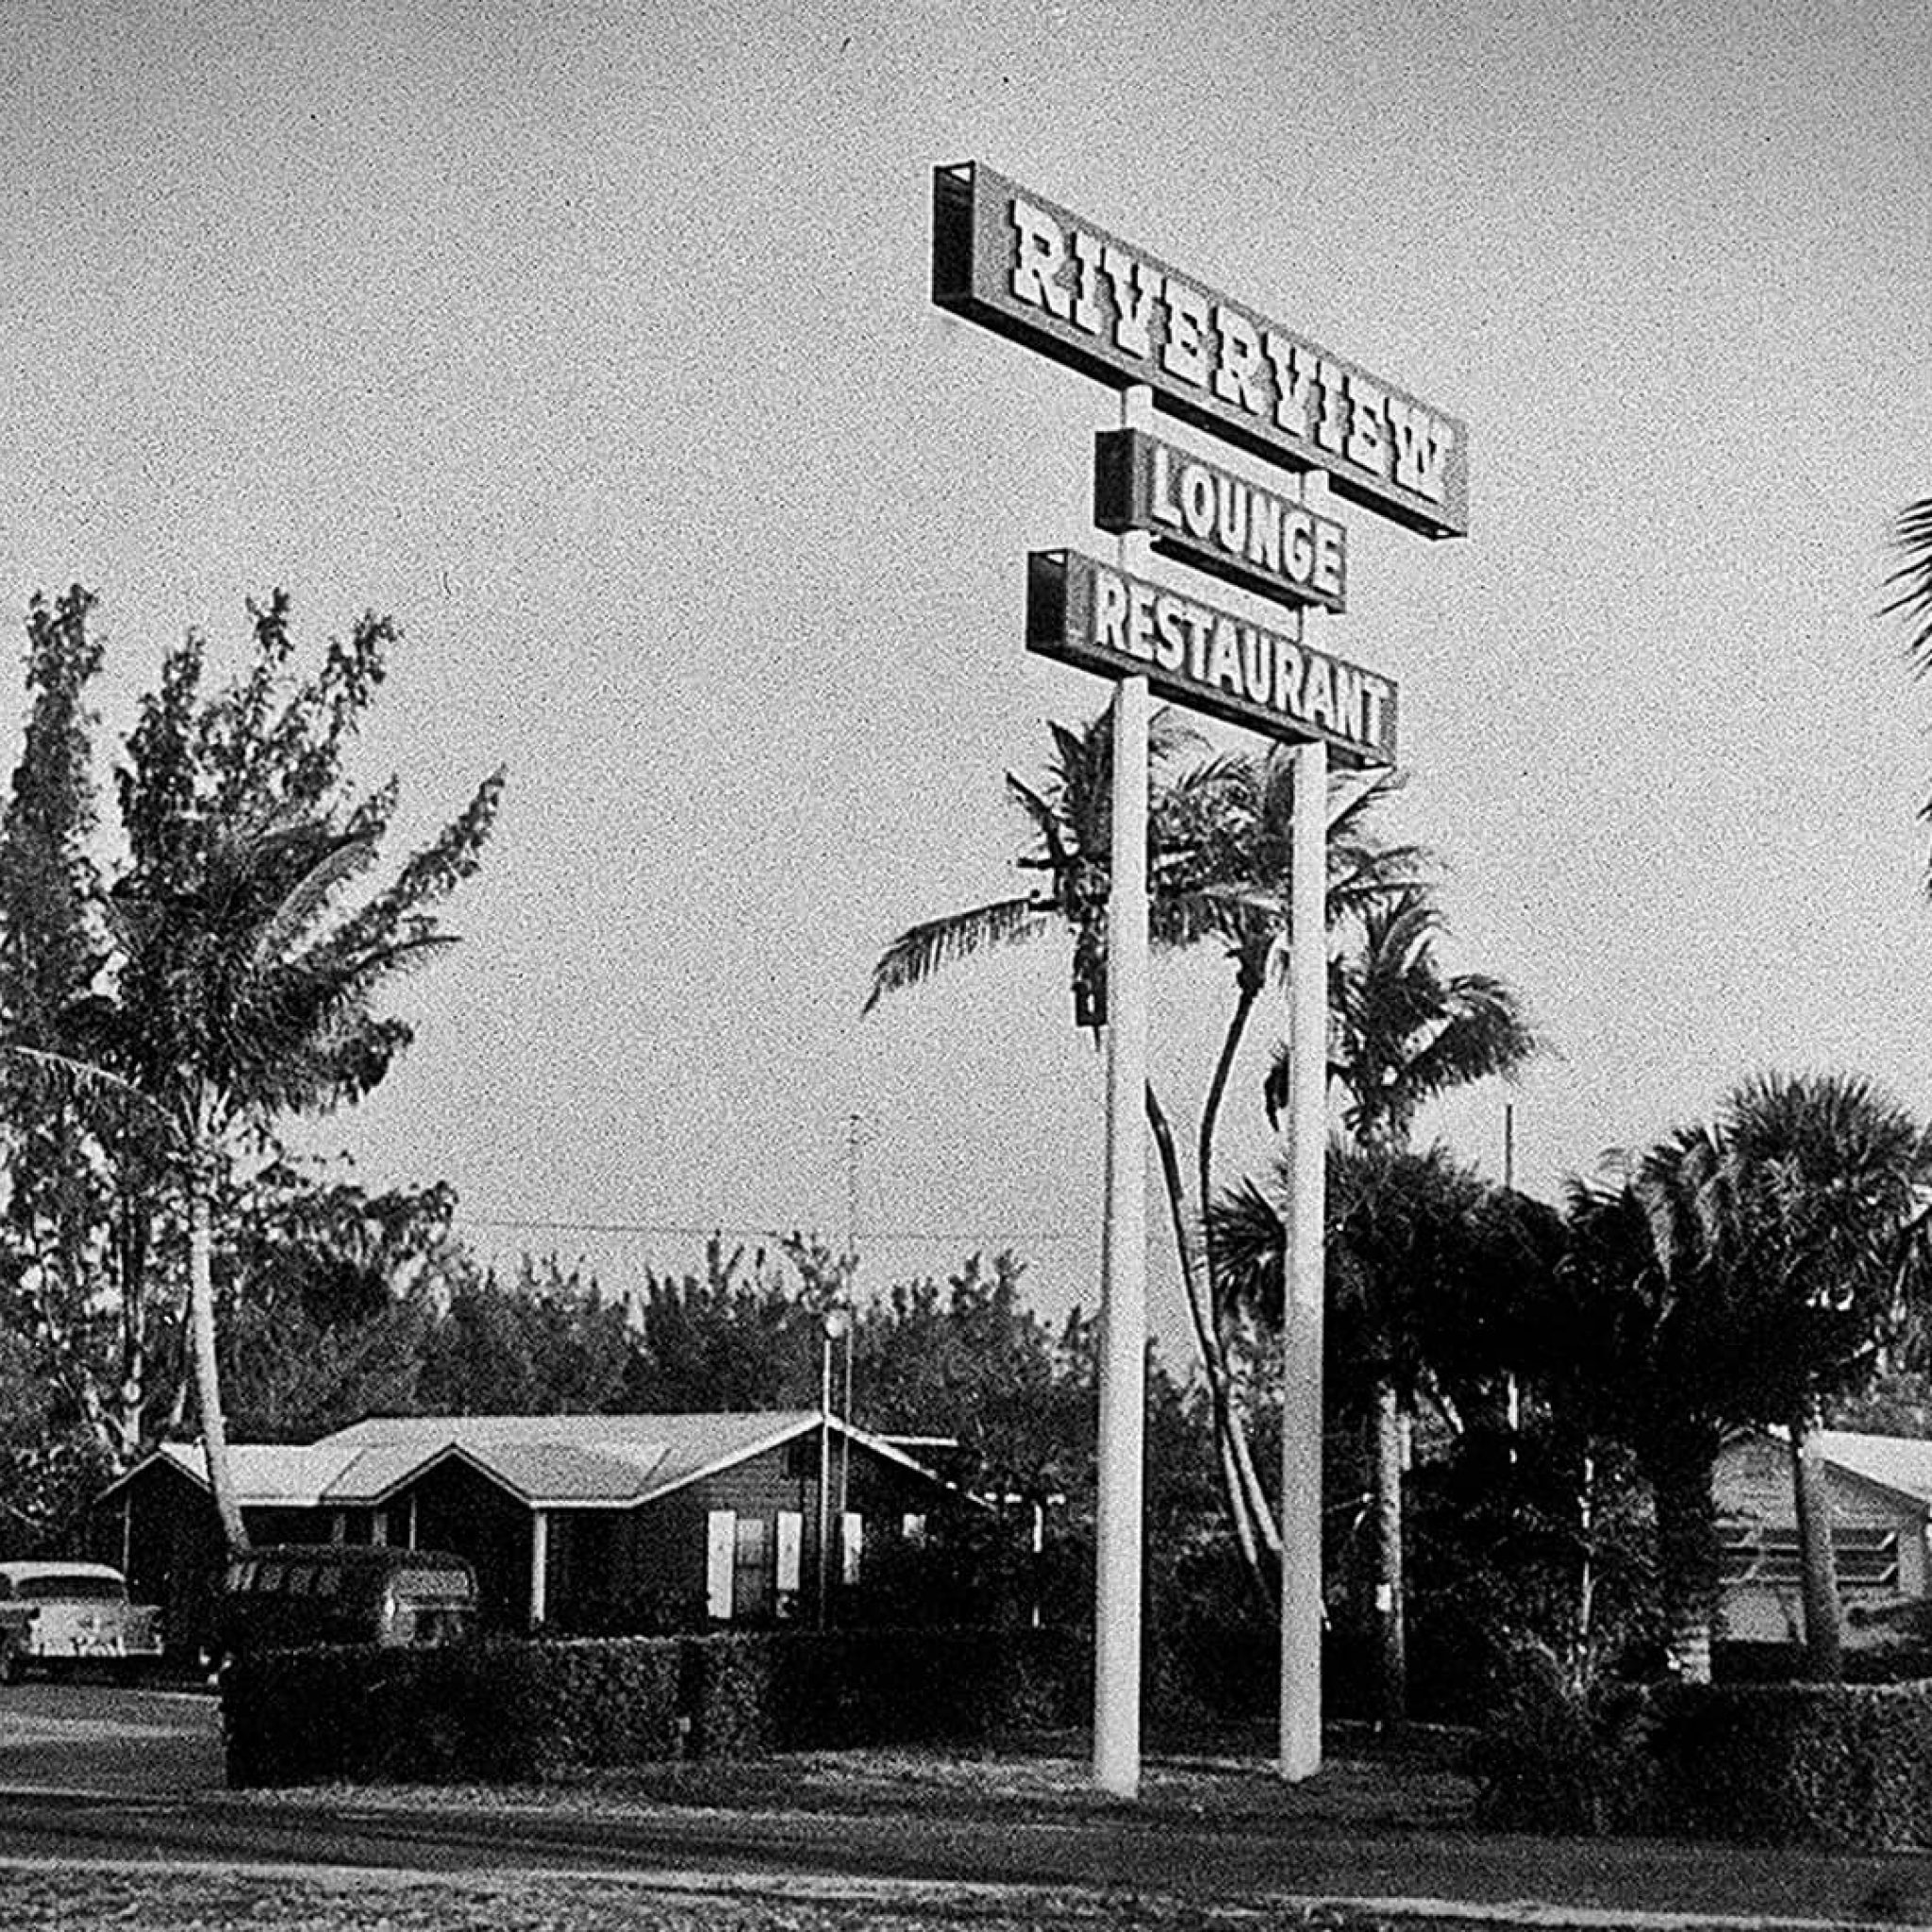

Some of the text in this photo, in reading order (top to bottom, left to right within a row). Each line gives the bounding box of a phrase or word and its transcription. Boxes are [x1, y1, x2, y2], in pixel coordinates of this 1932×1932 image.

[1010, 199, 1454, 504] RIVERVIEW
[1151, 446, 1343, 595] LOUNGE
[1094, 570, 1391, 746] RESTAURANT
